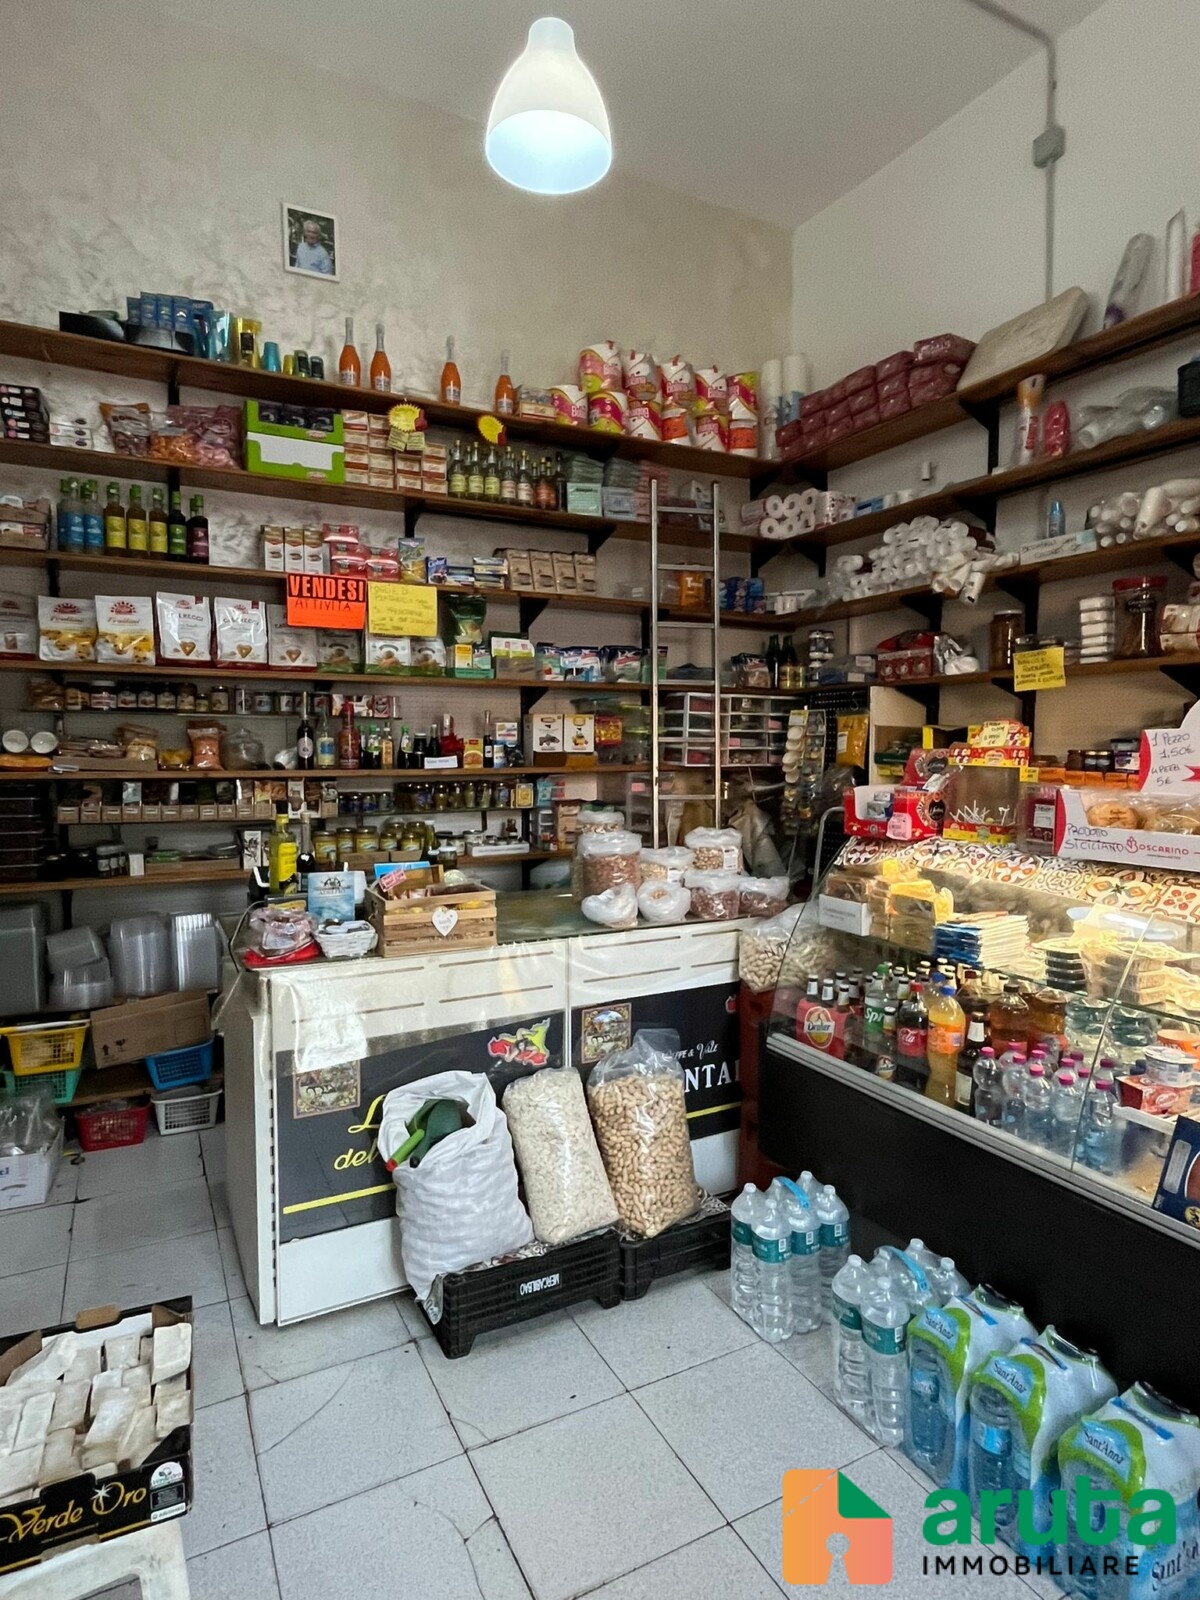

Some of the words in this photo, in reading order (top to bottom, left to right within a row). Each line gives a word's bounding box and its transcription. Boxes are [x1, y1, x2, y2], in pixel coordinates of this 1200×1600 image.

[289, 575, 364, 601] VENDESI
[1162, 732, 1191, 746] PEZZO
[1160, 745, 1195, 759] 1,50€
[1158, 763, 1181, 774] PEZZI
[1064, 839, 1124, 853] SICILIANO
[1125, 836, 1190, 856] BOSCARINO
[519, 1273, 560, 1297] MERCABILBAO
[925, 1310, 955, 1341] Sant'Anna
[993, 1359, 1028, 1395] Sant'Anna
[1083, 1429, 1126, 1466] Sant'Anna
[0, 1500, 84, 1544] Verde
[91, 1480, 148, 1515] Oro
